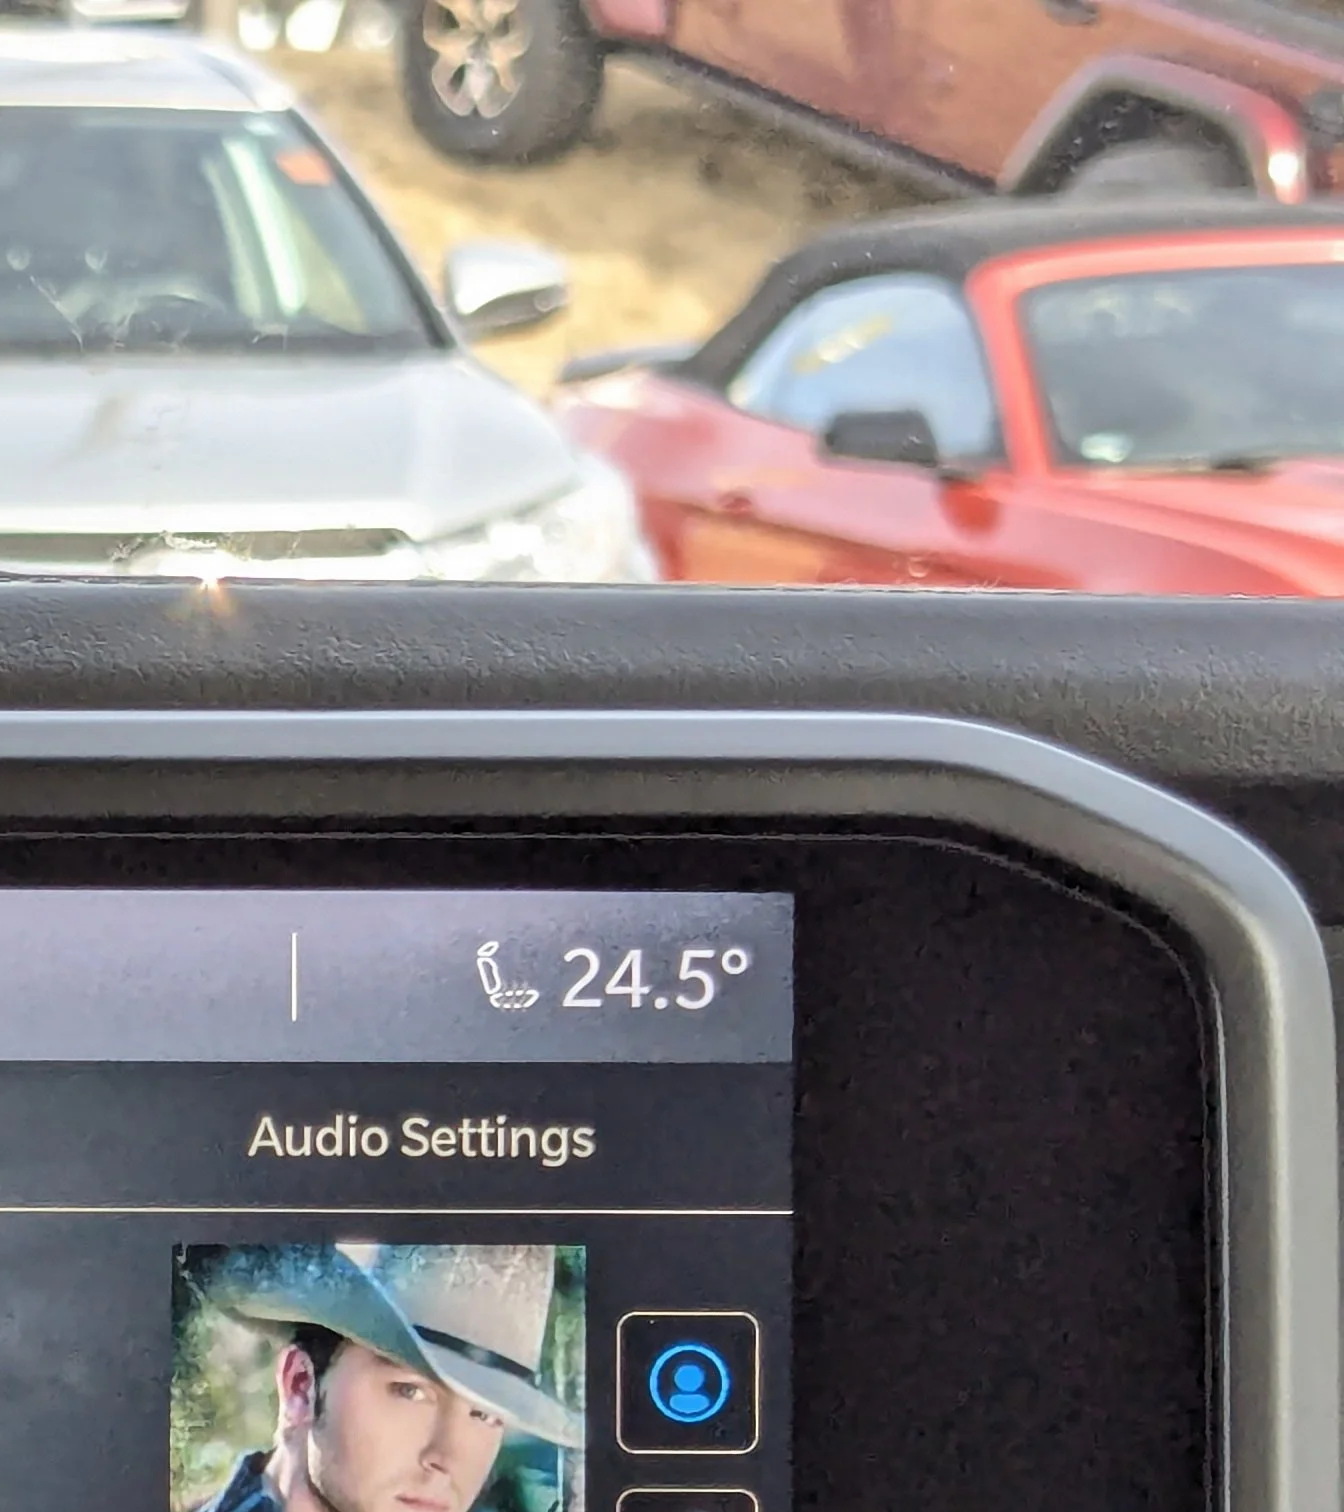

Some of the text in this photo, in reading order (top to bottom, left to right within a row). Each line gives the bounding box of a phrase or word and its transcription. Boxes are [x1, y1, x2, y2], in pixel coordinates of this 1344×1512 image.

[561, 947, 750, 1010] 24.5°
[247, 1113, 596, 1168] Audio Settings
